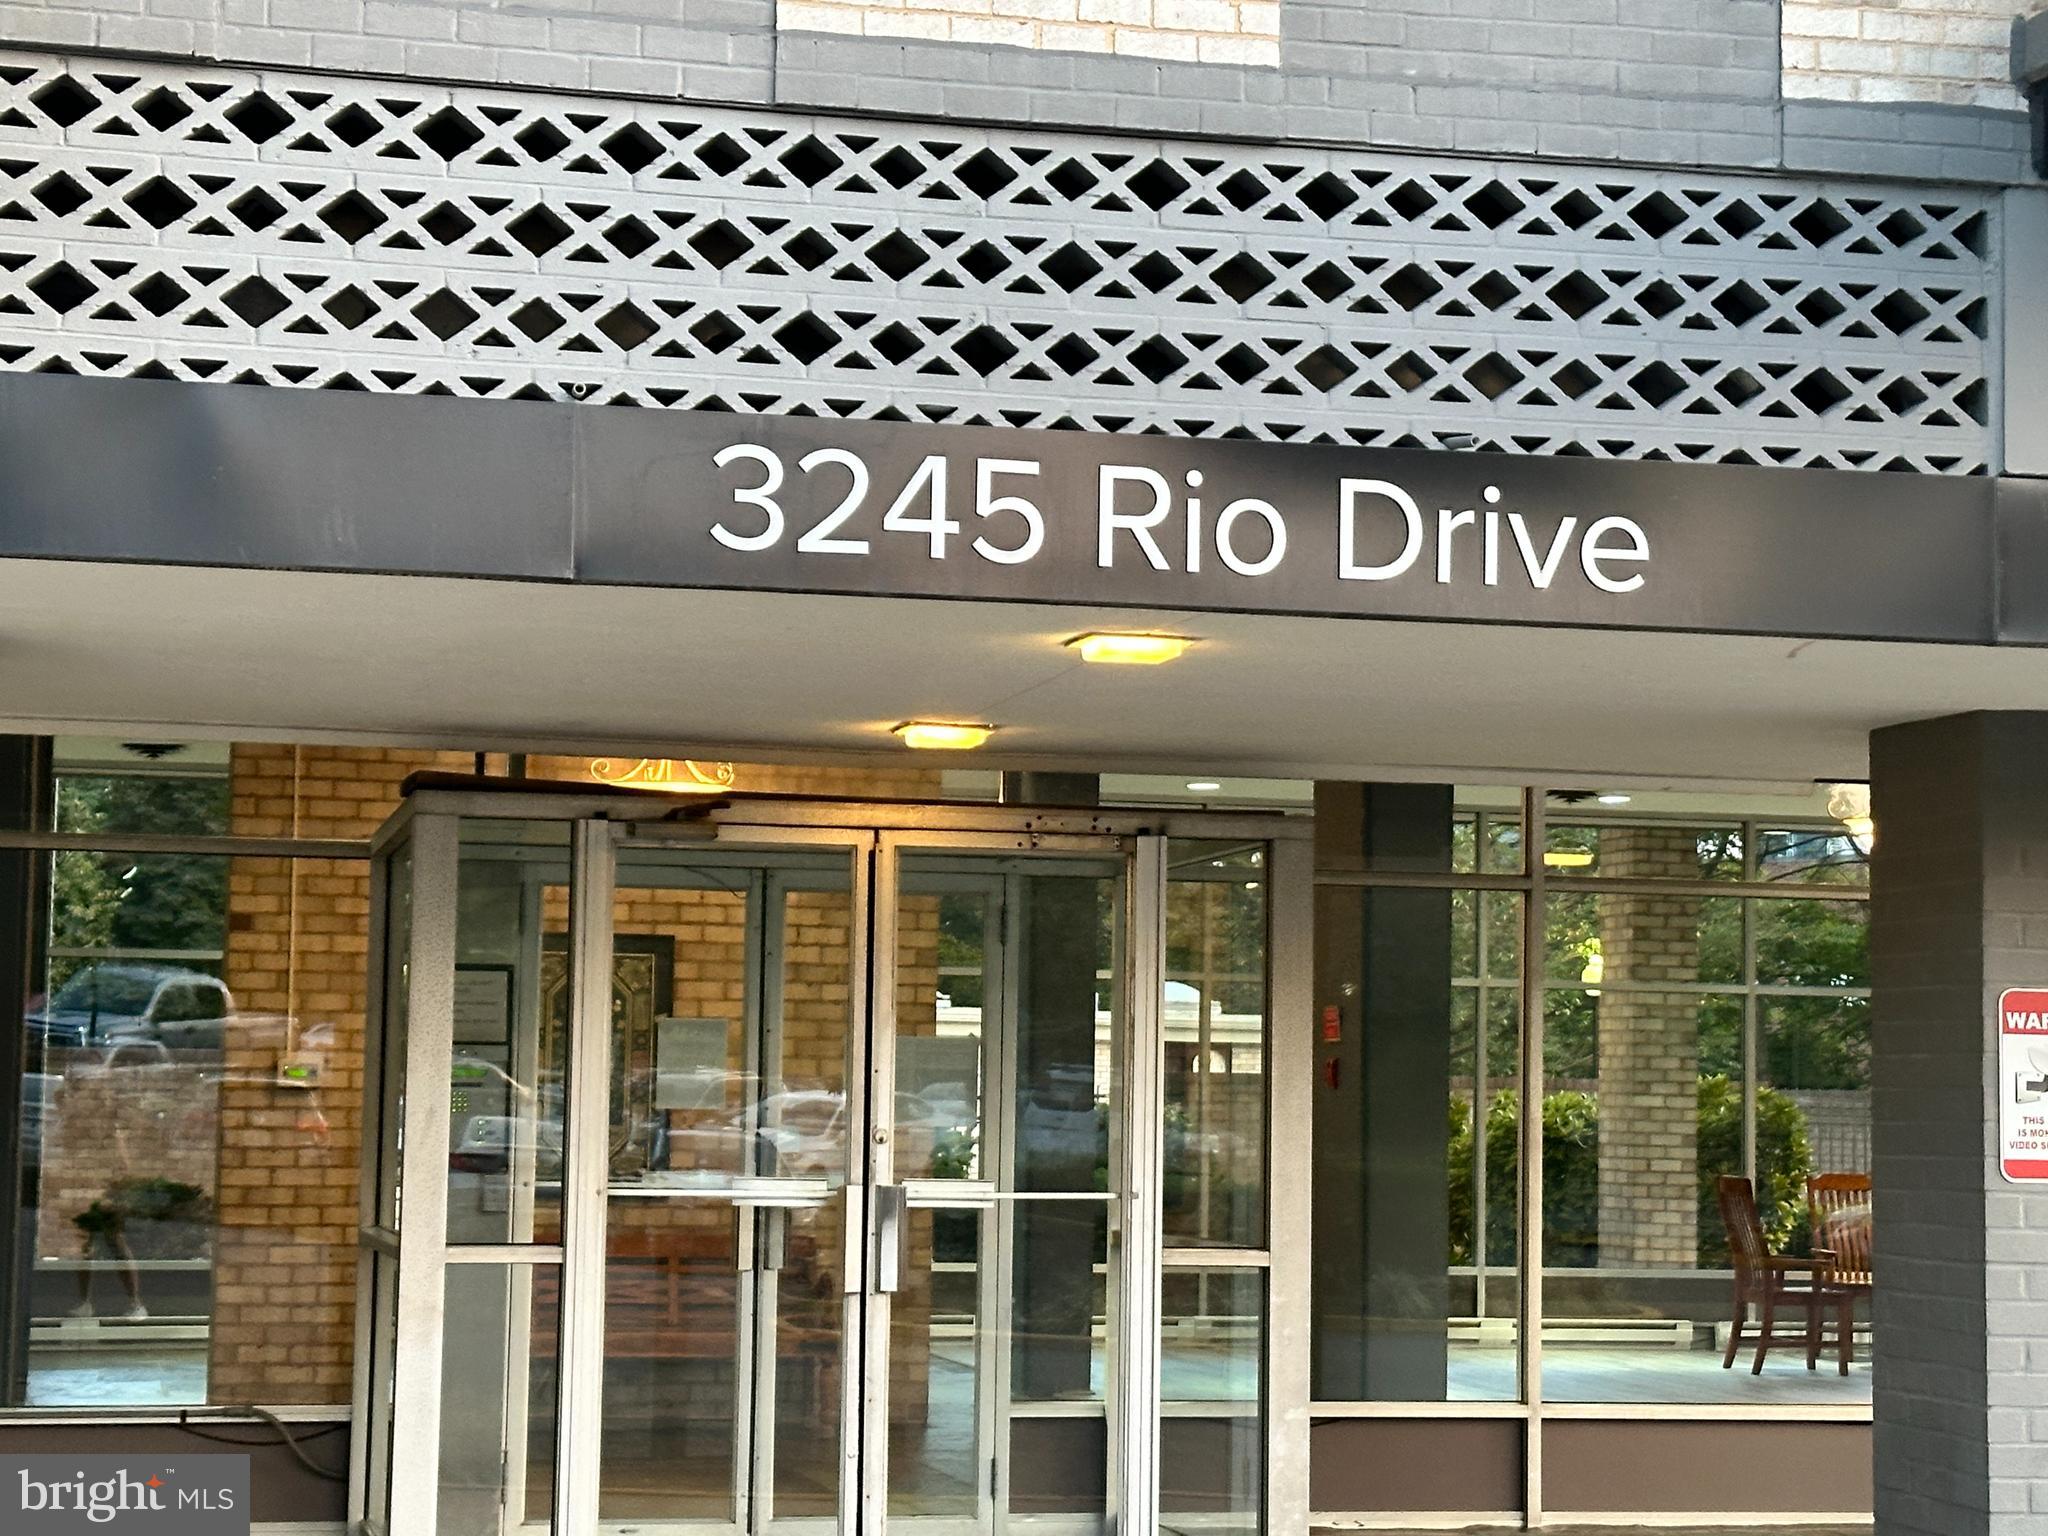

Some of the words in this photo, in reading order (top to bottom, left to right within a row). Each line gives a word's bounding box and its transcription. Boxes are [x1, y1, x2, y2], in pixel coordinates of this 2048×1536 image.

[710, 444, 1044, 563] 3245
[1099, 465, 1287, 575] Rio
[1340, 479, 1649, 592] Drive
[2022, 1116, 2045, 1125] THIS
[2018, 1128, 2027, 1137] IS
[2009, 1141, 2038, 1150] VIDEO
[2040, 1141, 2048, 1150] S
